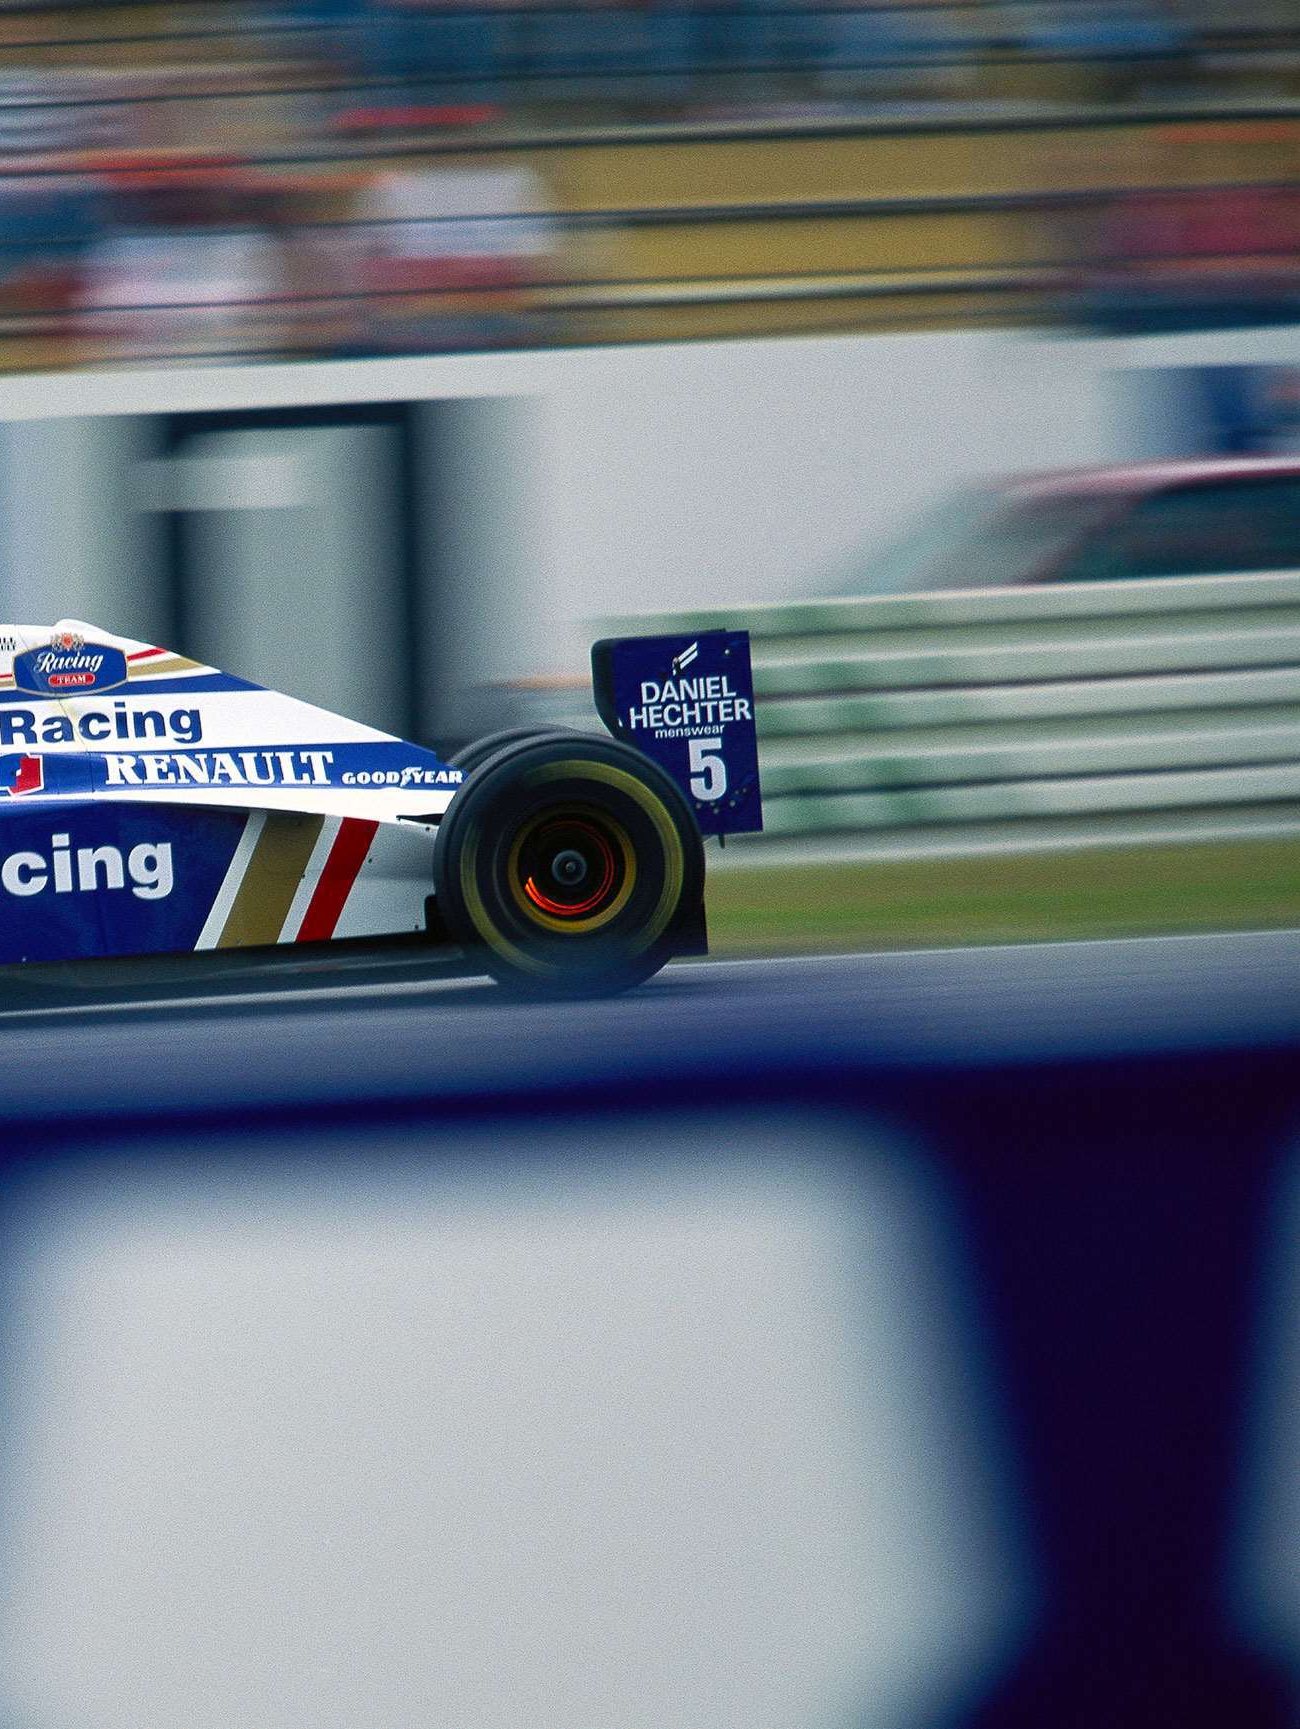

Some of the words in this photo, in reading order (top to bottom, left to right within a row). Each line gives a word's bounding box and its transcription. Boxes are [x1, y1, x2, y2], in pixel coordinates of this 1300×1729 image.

[33, 651, 103, 673] Racing
[57, 675, 86, 684] TEAM
[641, 676, 736, 704] DANIEL
[629, 698, 752, 729] HECHTER
[655, 724, 724, 739] menswear
[102, 751, 333, 785] RENAULT
[688, 737, 727, 801] 5
